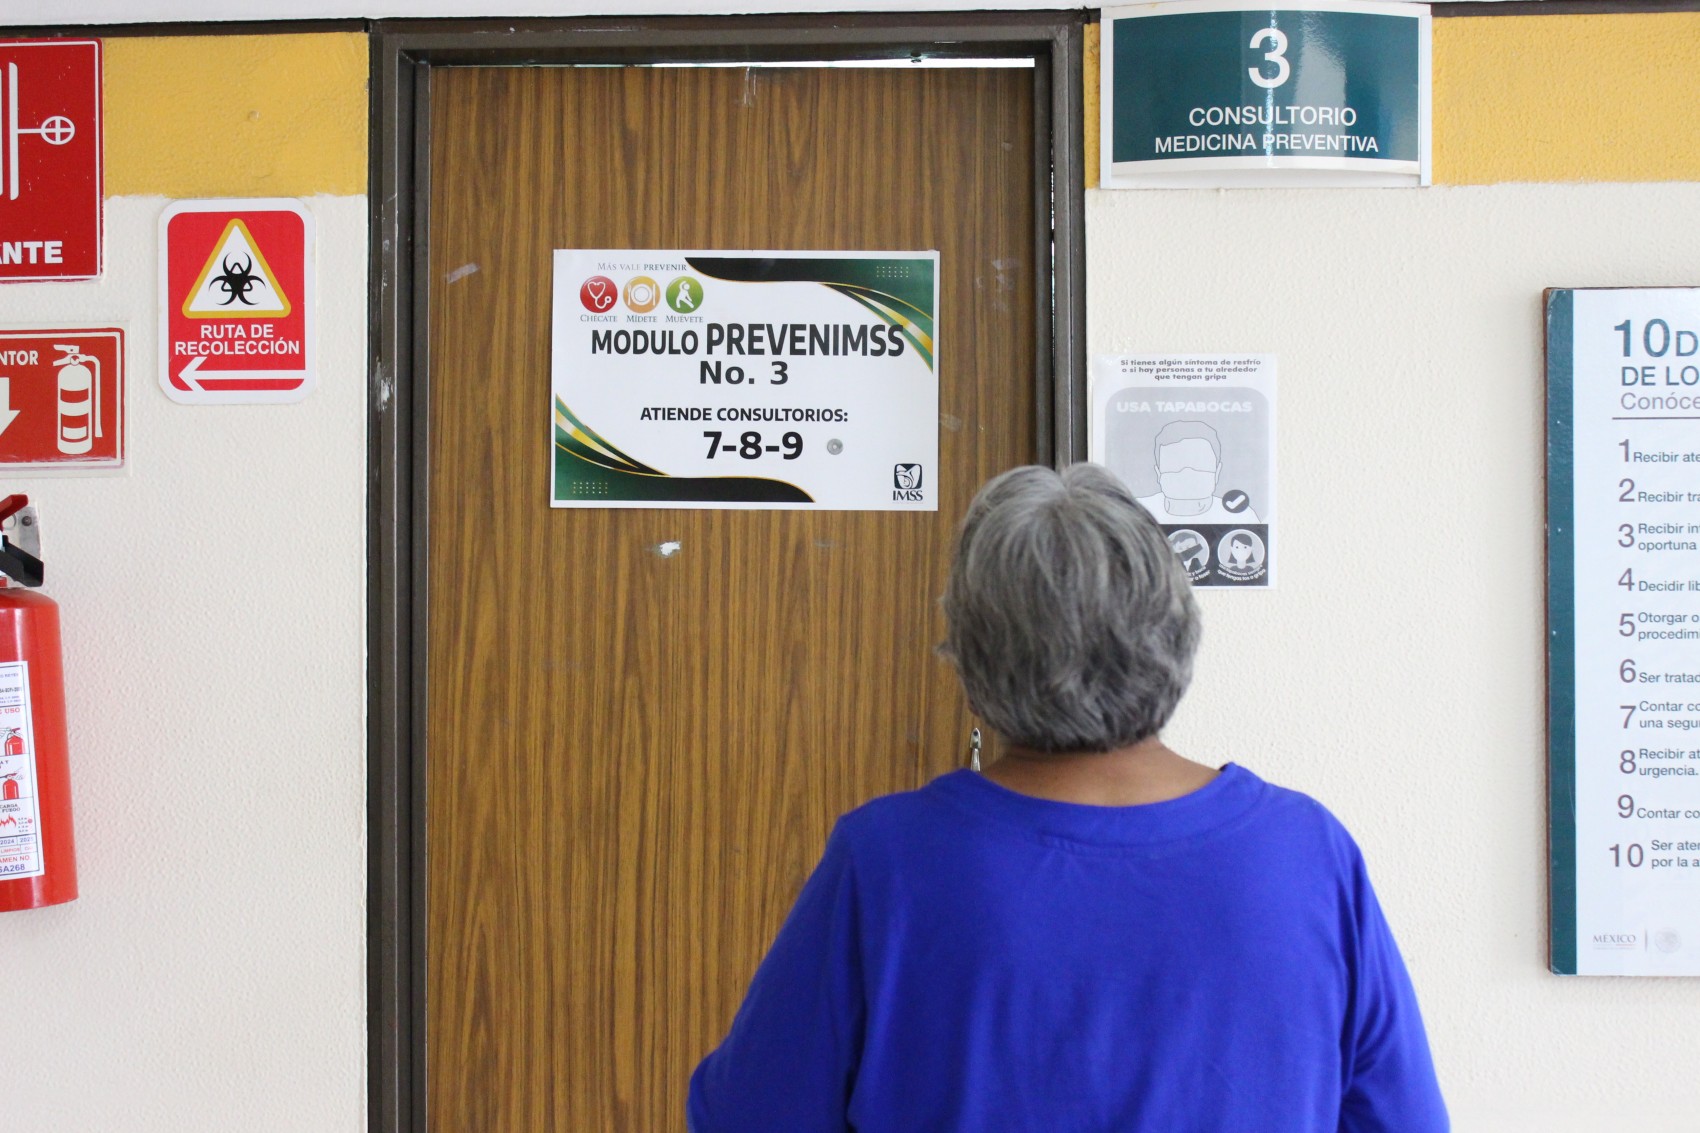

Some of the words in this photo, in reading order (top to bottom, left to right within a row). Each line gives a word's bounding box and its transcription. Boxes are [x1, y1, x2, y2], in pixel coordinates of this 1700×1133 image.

[1248, 27, 1290, 88] 3
[1189, 106, 1357, 127] CONSULTORIO
[1155, 134, 1257, 153] MEDICINA
[1263, 134, 1379, 152] PREVENTIVA
[0, 241, 63, 264] NTE
[643, 263, 687, 271] PREVENIR
[200, 324, 247, 338] RUTA
[251, 324, 274, 338] DE
[591, 330, 699, 355] MODULO
[706, 323, 905, 357] PREVENIMSS
[1614, 318, 1670, 357] 10
[175, 337, 300, 355] RECOLECCIÓN
[699, 360, 755, 385] No.
[770, 360, 789, 385] 3
[1621, 366, 1656, 386] DE
[1666, 365, 1700, 386] LO
[640, 407, 712, 421] ATIENDE
[716, 407, 849, 422] CONSULTORIOS:
[1116, 401, 1151, 413] USA
[1154, 401, 1253, 413] TAPABOCAS
[703, 431, 804, 459] 7-8-9
[1619, 439, 1630, 462] 1
[1633, 451, 1679, 463] Recibir
[893, 490, 923, 501] IMSS
[1619, 478, 1635, 502] 2
[1638, 492, 1684, 503] Recibir
[1618, 523, 1635, 548] 3
[1638, 523, 1684, 534] Recibir
[1638, 540, 1697, 552] oportuna
[1618, 567, 1635, 591] 4
[1638, 580, 1684, 591] Decidir
[1619, 613, 1635, 637] 5
[1638, 612, 1687, 625] Otorgar
[1619, 658, 1636, 683] 6
[1639, 672, 1661, 683] Ser
[1620, 705, 1636, 729] 7
[1639, 701, 1683, 712] Contar
[1639, 719, 1663, 729] una
[1619, 749, 1636, 774] 8
[1639, 748, 1685, 760] Recibir
[1639, 765, 1699, 778] urgencia.
[1617, 794, 1634, 819] 9
[1637, 807, 1680, 819] Contar
[1609, 843, 1644, 867] 10
[1651, 840, 1673, 851] Ser
[1651, 858, 1673, 869] por
[1677, 856, 1688, 867] la
